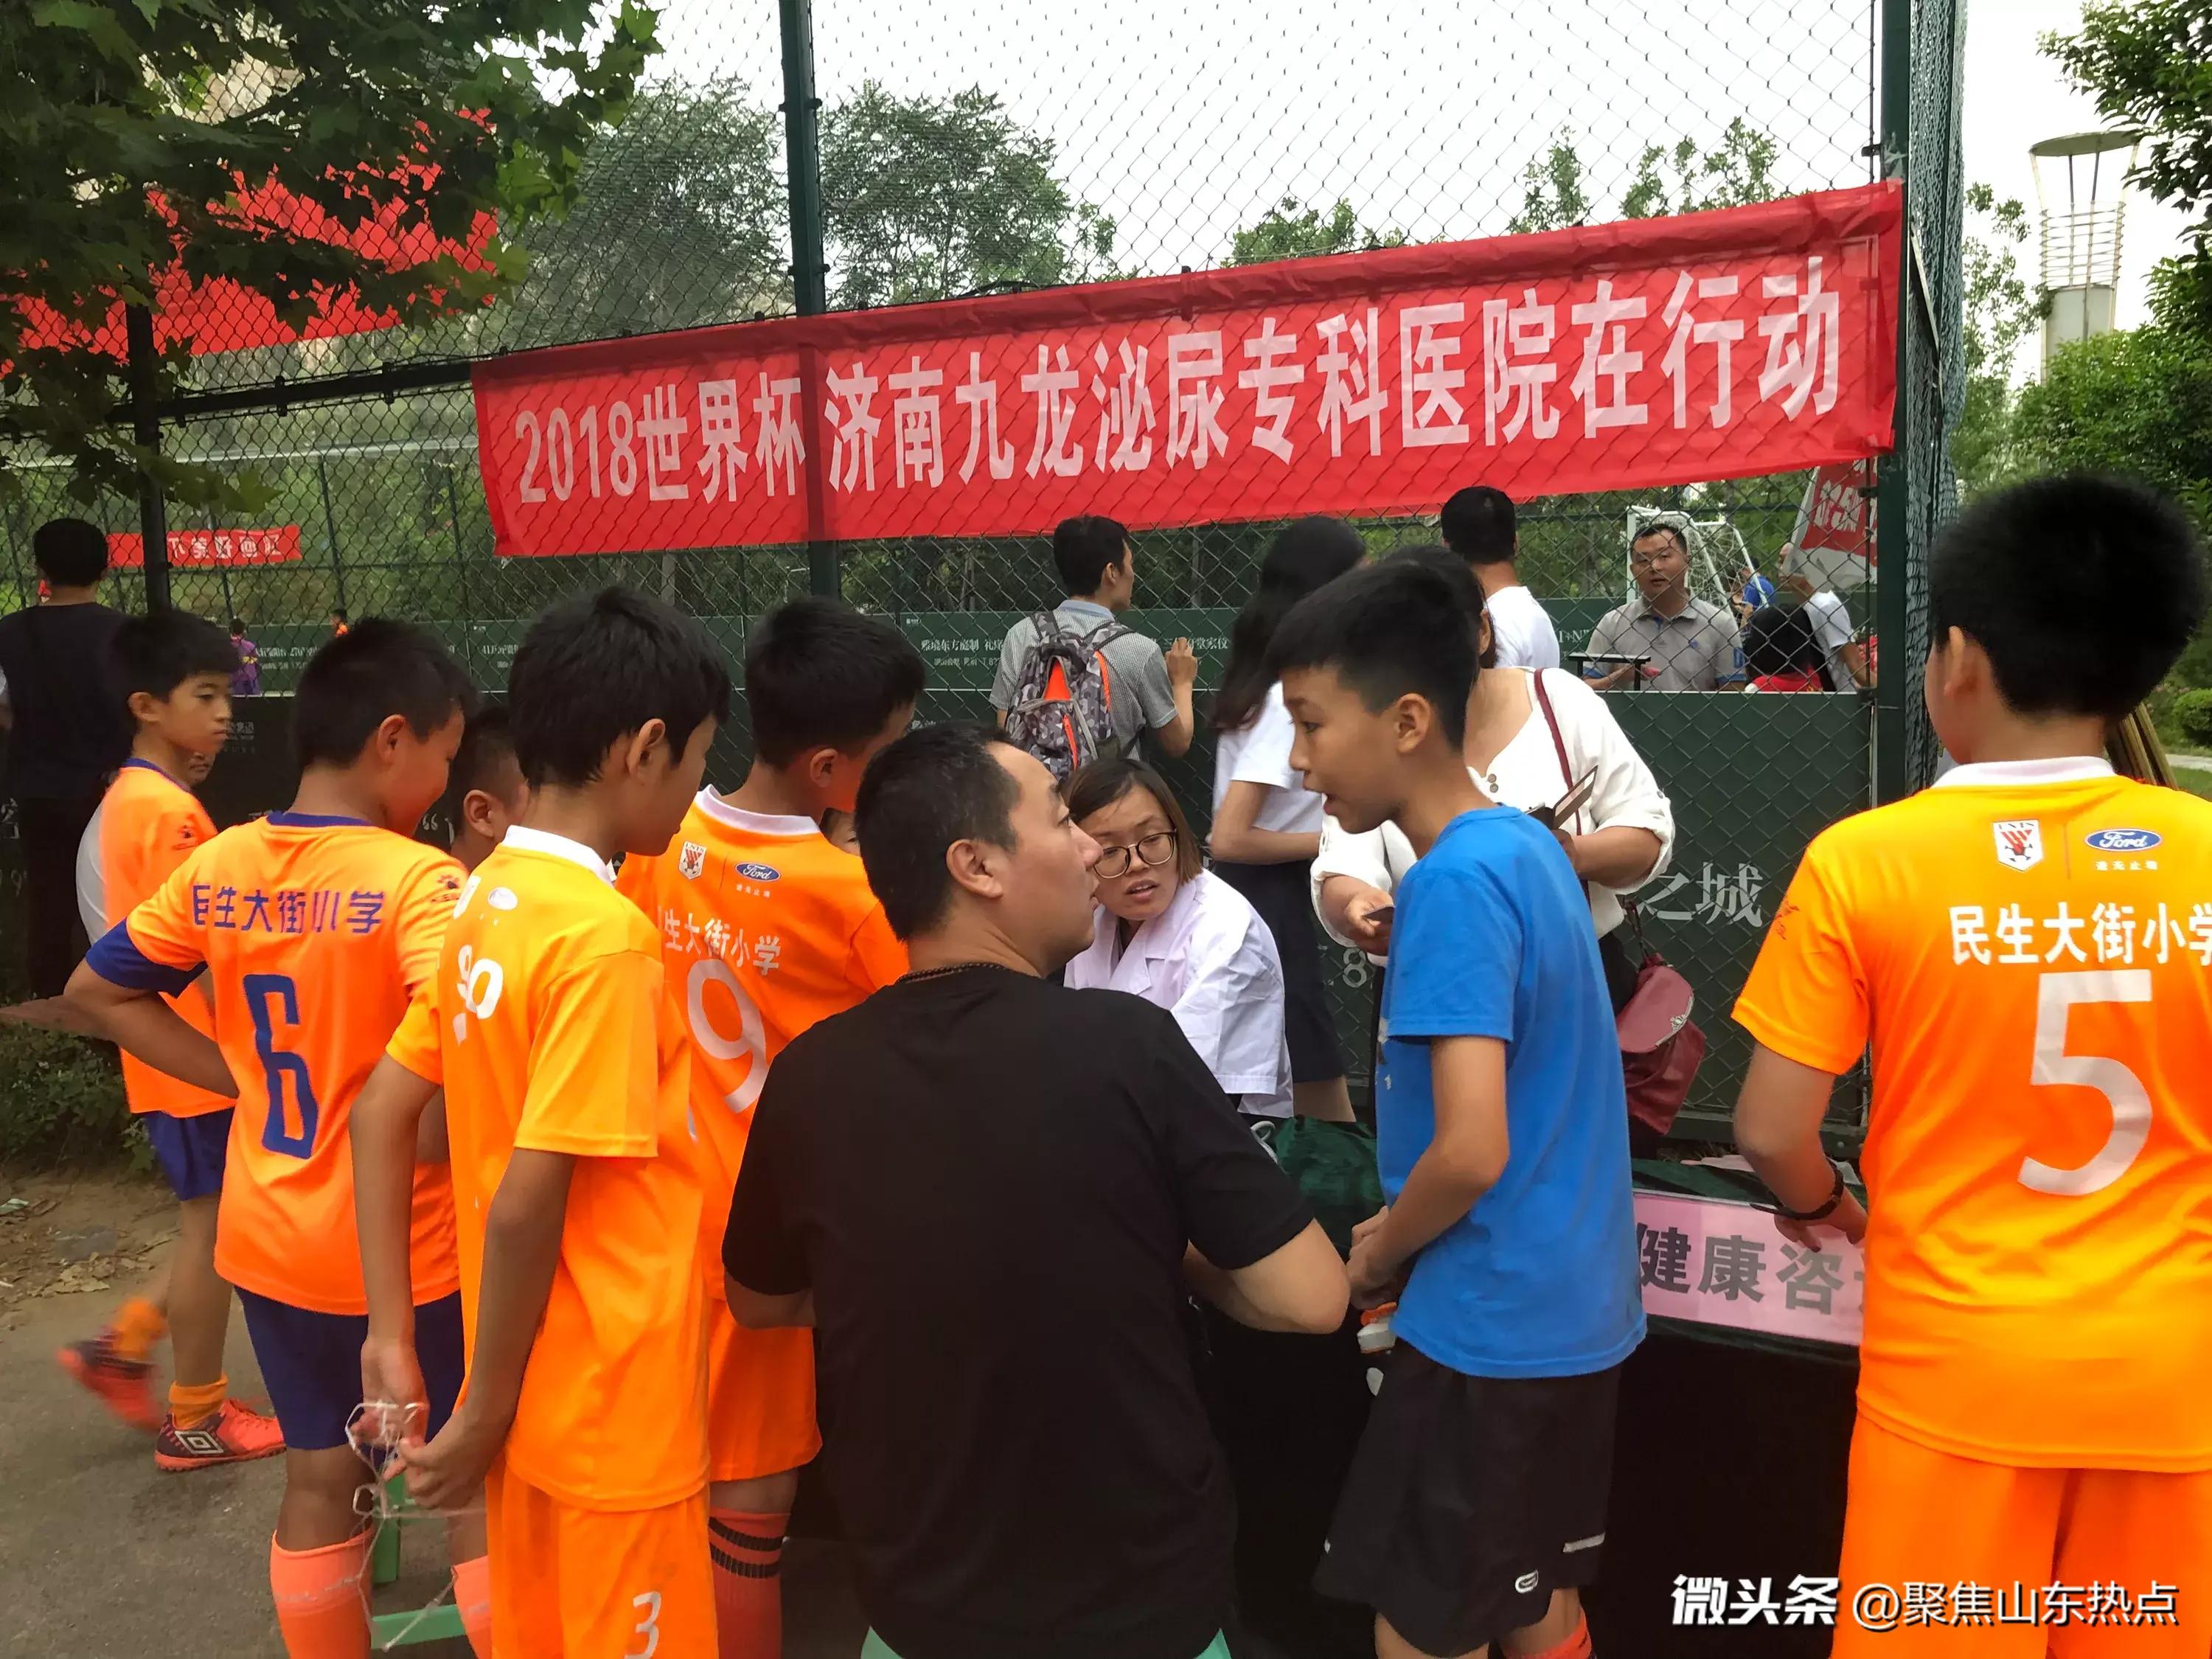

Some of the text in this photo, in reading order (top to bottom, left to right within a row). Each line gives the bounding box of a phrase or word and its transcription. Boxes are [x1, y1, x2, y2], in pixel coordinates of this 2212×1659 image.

[515, 255, 1840, 504] 2018世界杯 济南九龙泌尿专科医院在行动
[658, 906, 782, 976] 生大街小学
[243, 973, 319, 1159] 6
[687, 959, 772, 1114] 9
[2017, 968, 2154, 1197] 5
[1636, 1222, 1865, 1316] 健康咨
[623, 1590, 661, 1659] 3
